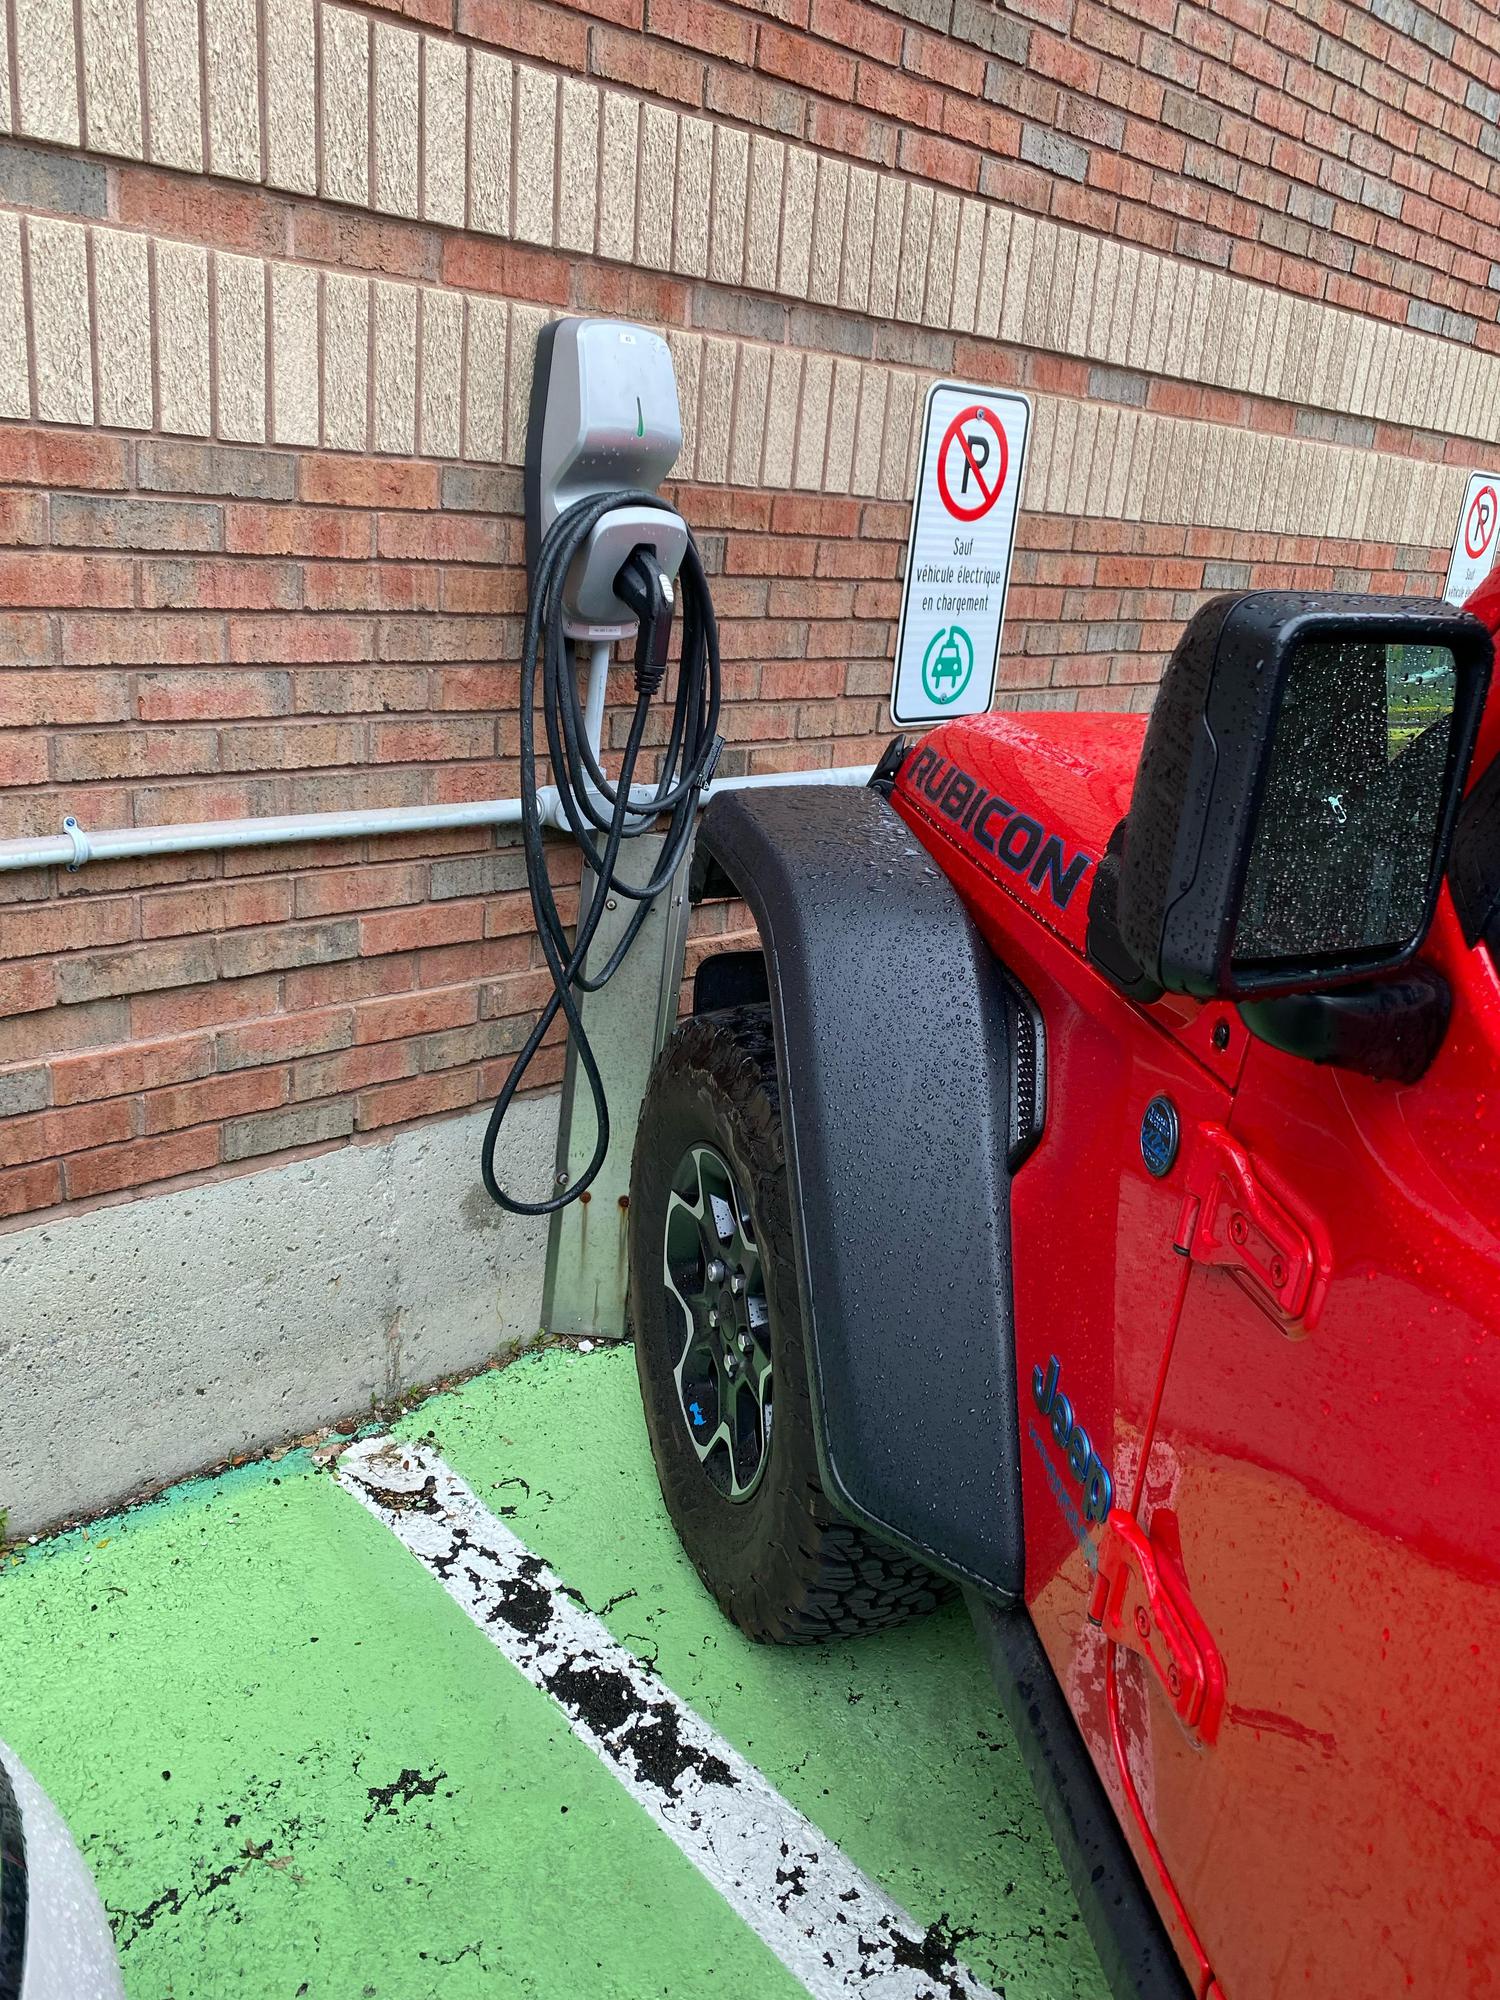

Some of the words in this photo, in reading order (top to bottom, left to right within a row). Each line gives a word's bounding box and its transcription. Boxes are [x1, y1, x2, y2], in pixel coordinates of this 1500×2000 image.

[961, 435, 990, 494] P
[953, 536, 974, 556] Sauf
[916, 564, 954, 583] véhicule
[957, 565, 1001, 587] électrique
[922, 596, 934, 611] en
[936, 594, 989, 616] chargement
[907, 746, 1093, 911] RUBICON
[1032, 1354, 1115, 1524] Jeep
